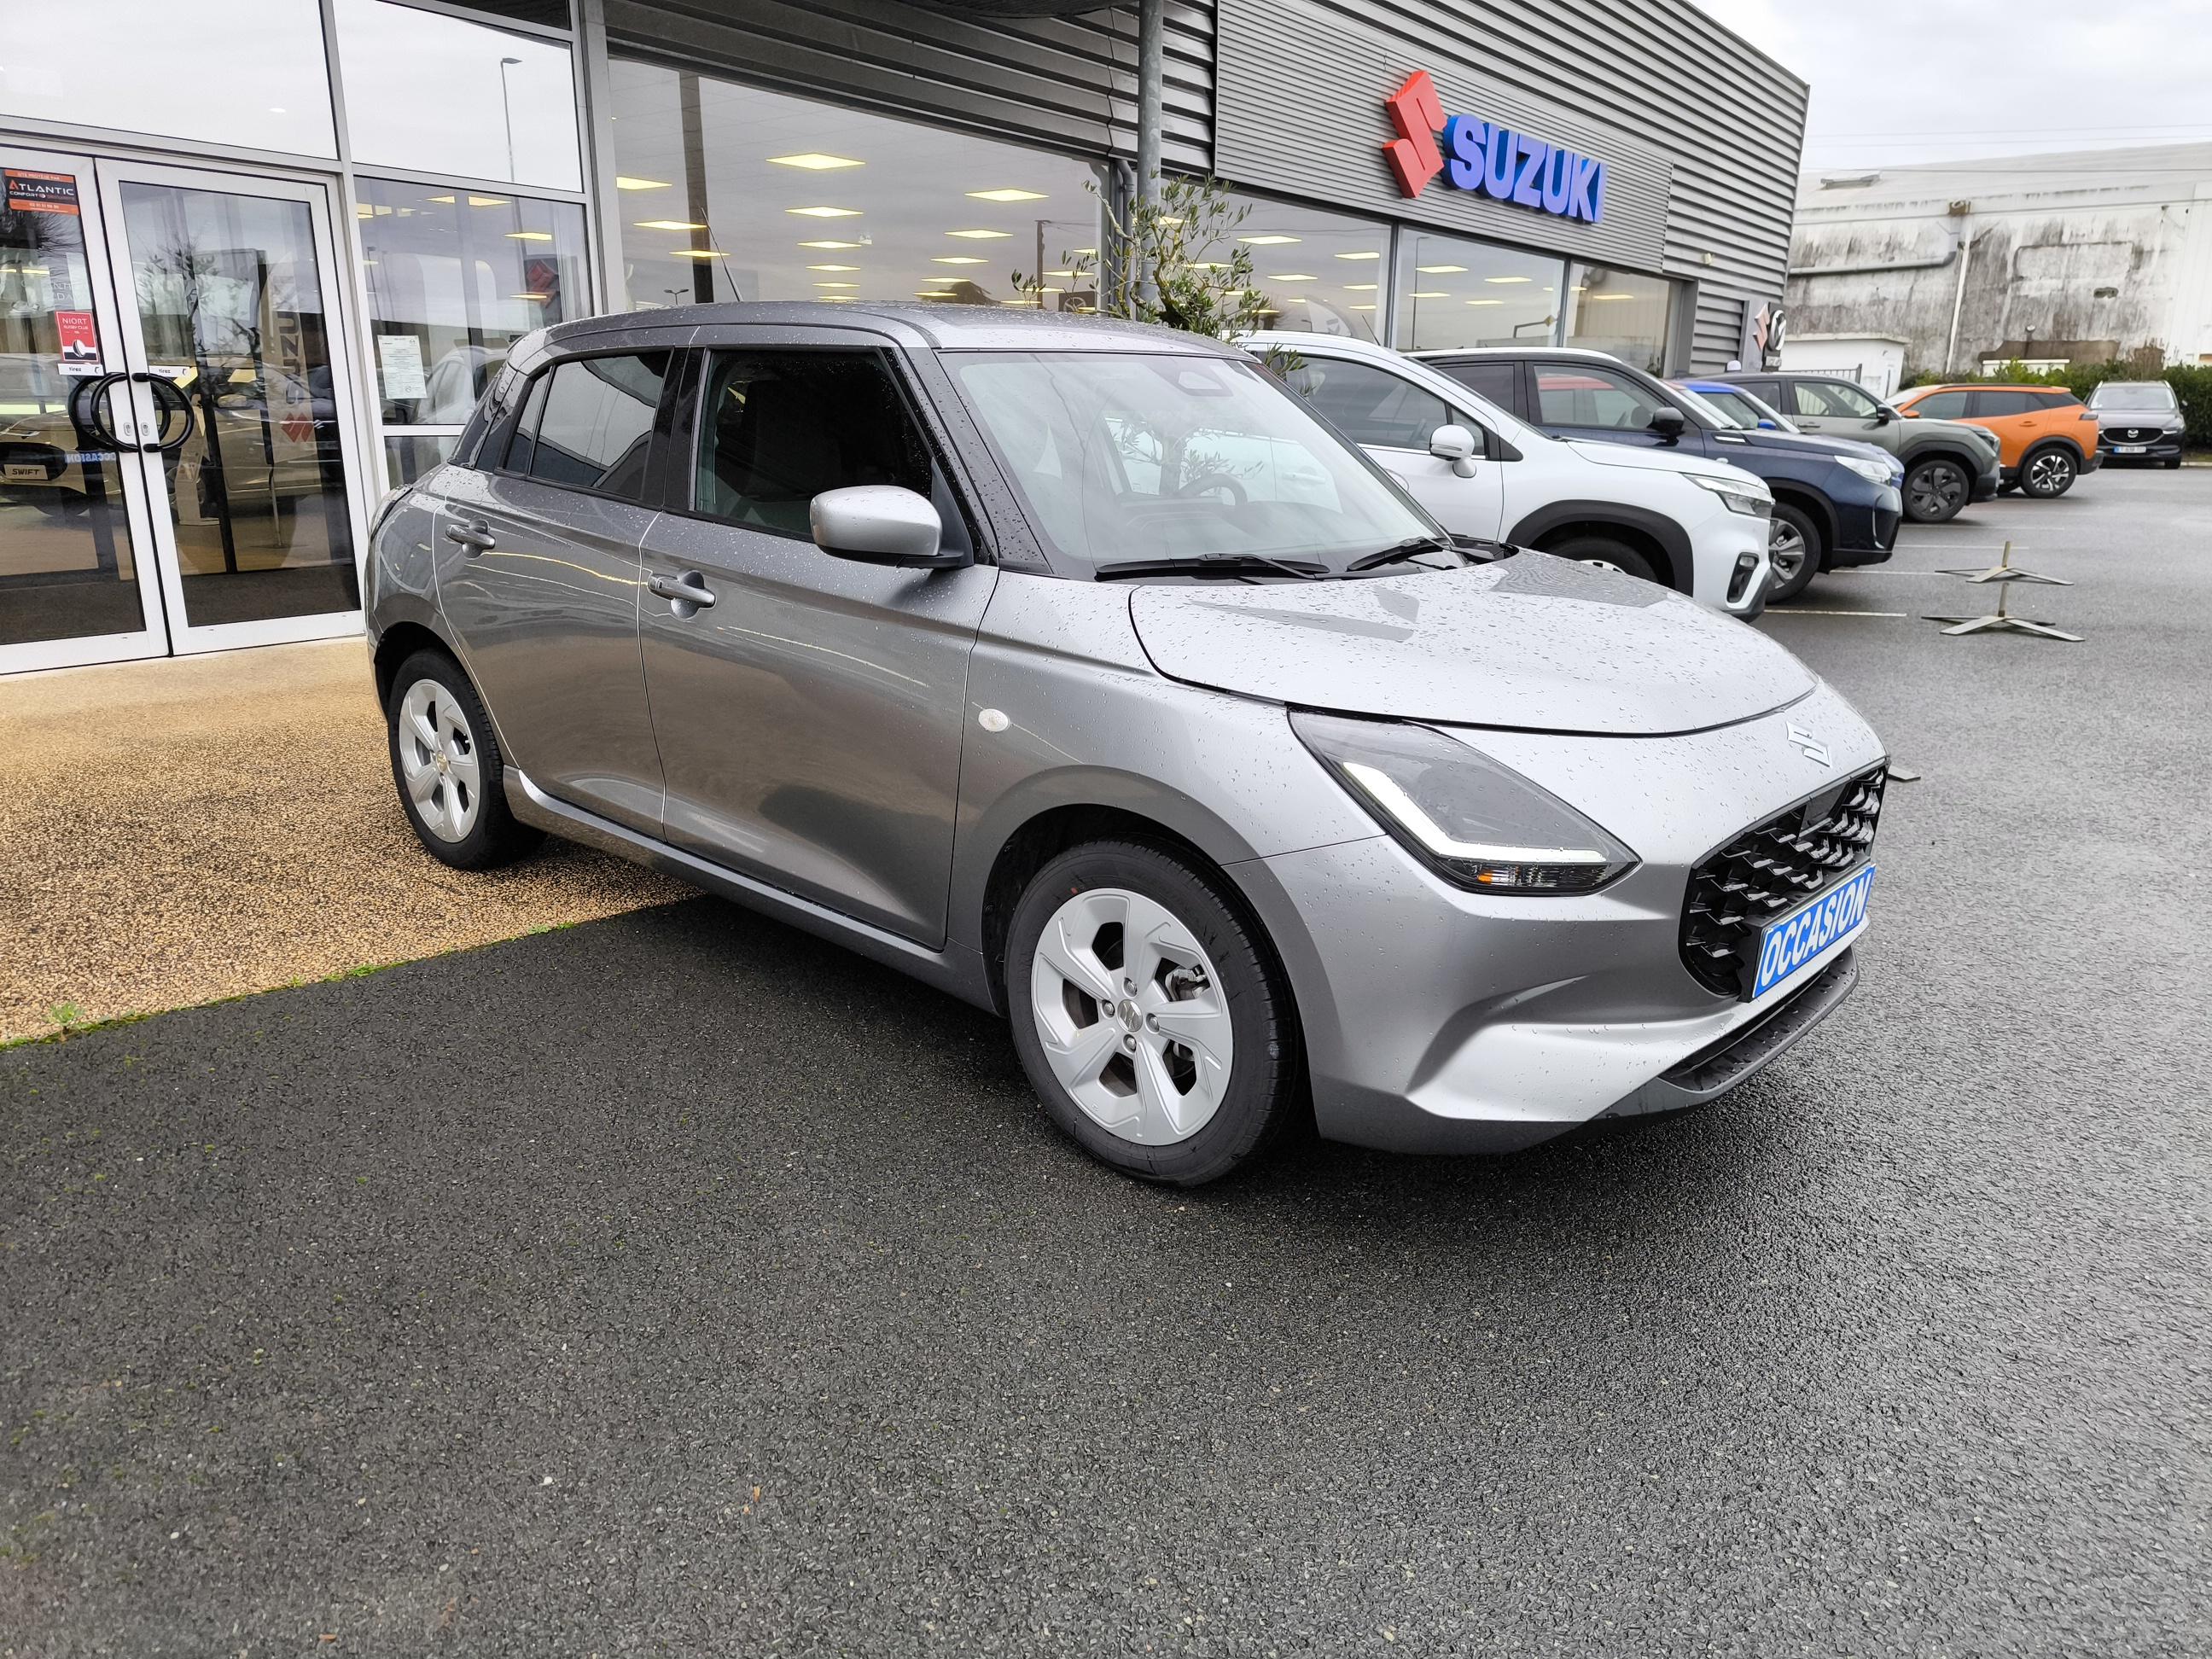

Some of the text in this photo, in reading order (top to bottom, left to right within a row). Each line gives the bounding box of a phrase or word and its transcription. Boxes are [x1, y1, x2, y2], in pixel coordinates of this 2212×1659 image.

[9, 179, 74, 195] ATLANTIC
[1447, 114, 1609, 224] SUZUKI
[1761, 871, 1872, 987] OCCASION
